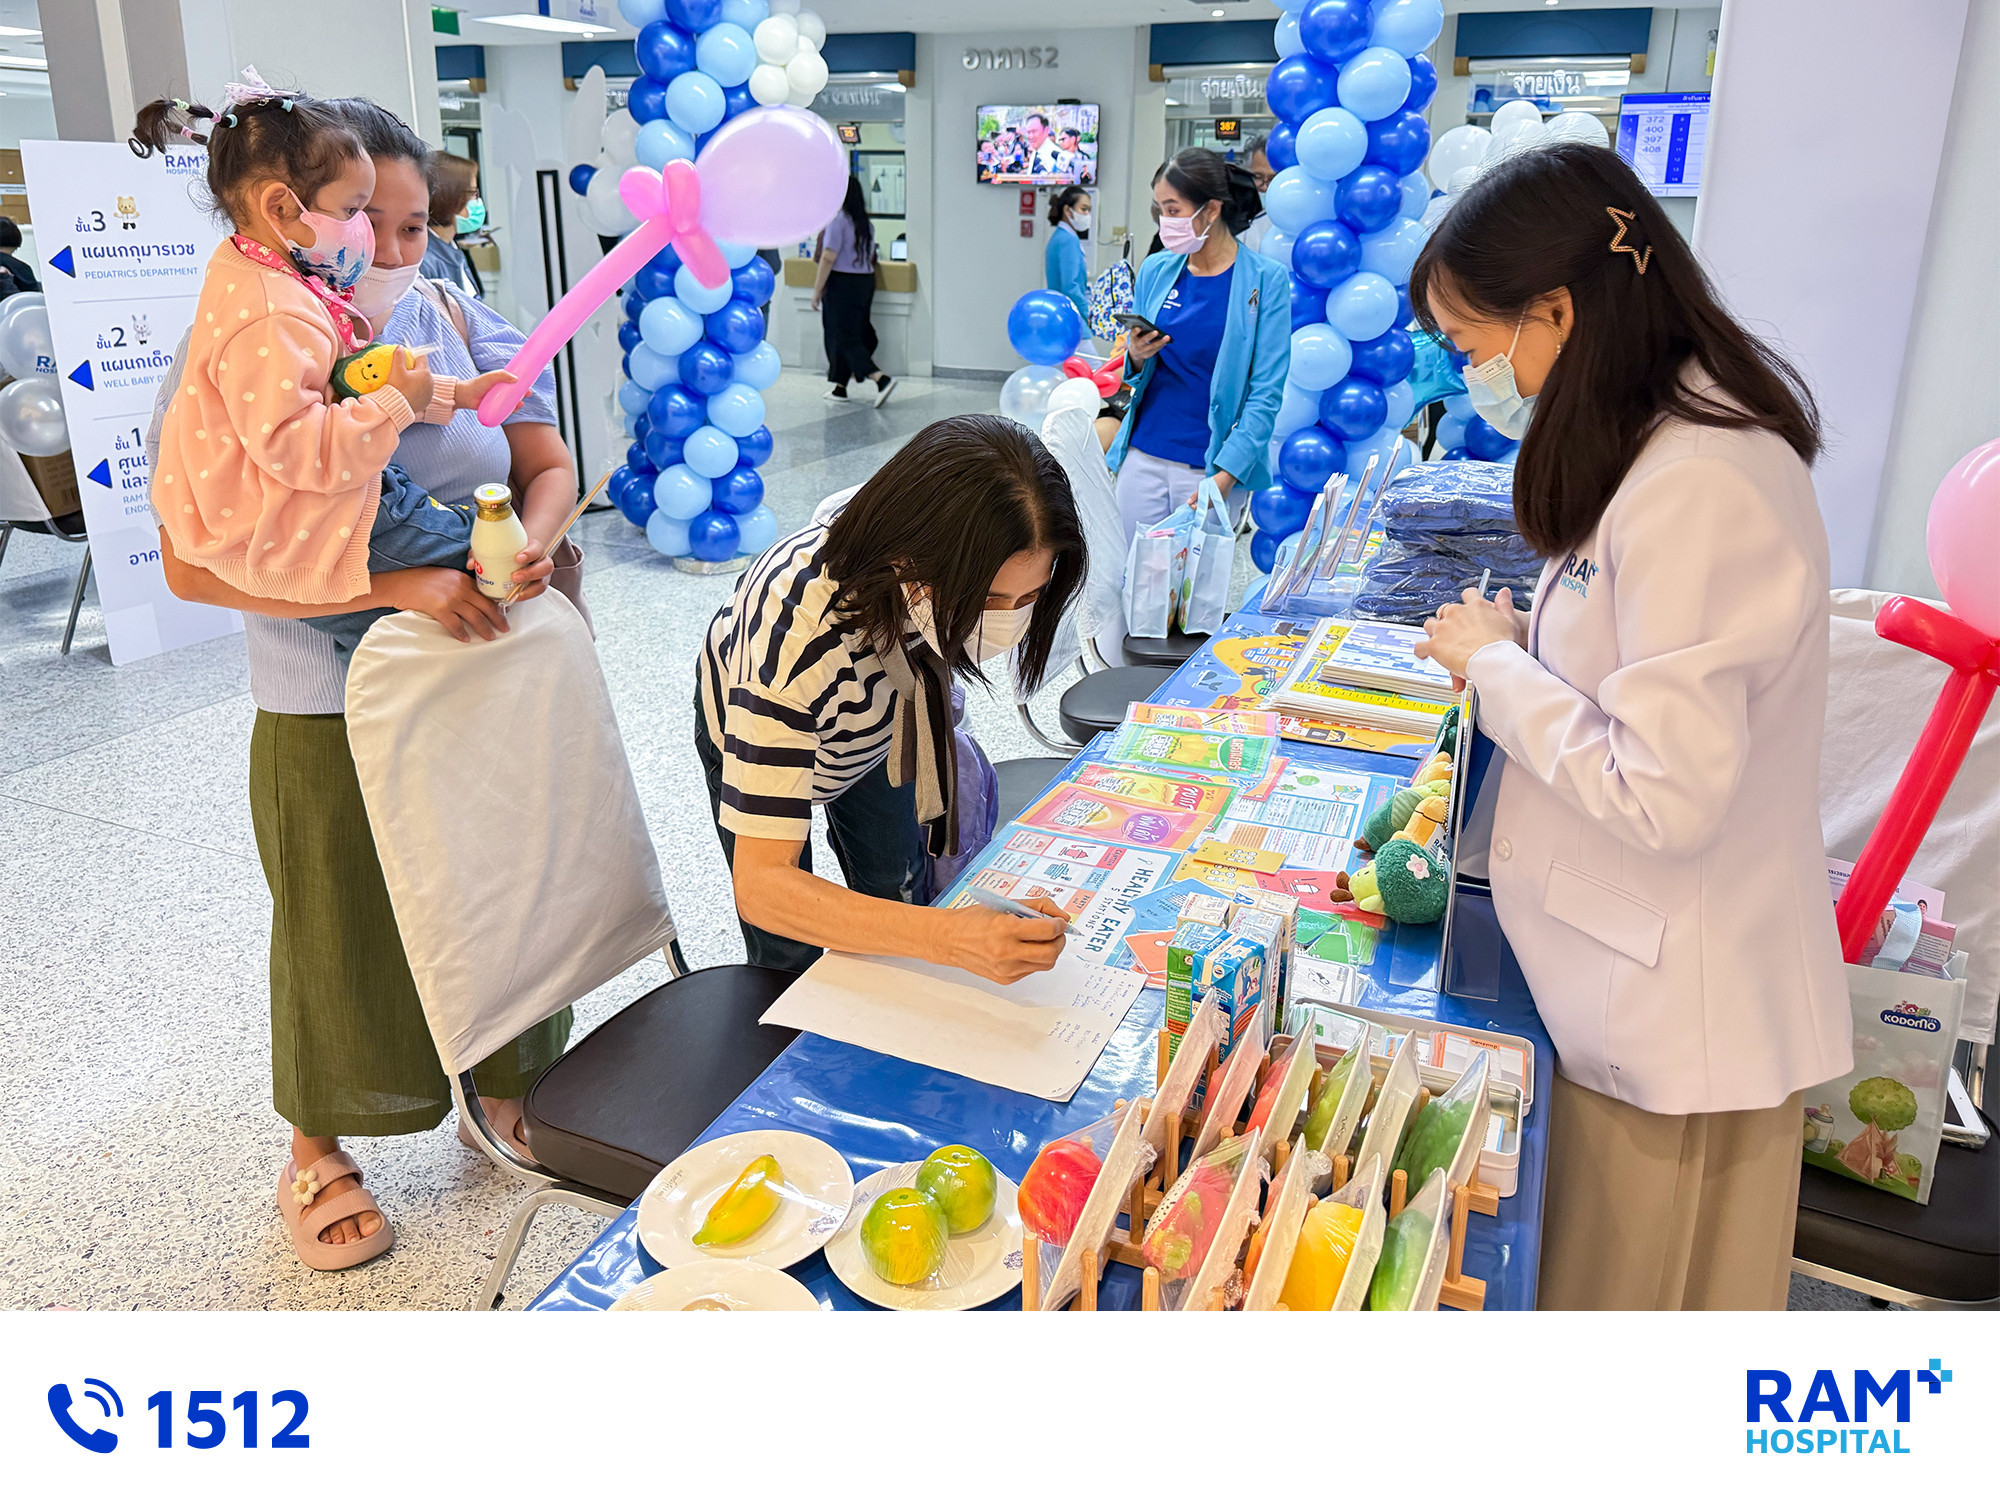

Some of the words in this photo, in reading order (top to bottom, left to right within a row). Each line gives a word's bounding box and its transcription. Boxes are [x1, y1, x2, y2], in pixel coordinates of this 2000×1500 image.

[1512, 69, 1581, 95] จ่ายเงิน
[1645, 115, 1665, 124] 372
[1644, 125, 1664, 133] 400
[1644, 135, 1663, 144] 397
[1642, 145, 1661, 153] 408
[164, 155, 200, 168] RAM
[82, 243, 195, 263] แผนกกุมารเวช
[84, 269, 138, 279] PEDIATRICS
[140, 267, 198, 277] DEPARTMENT
[103, 380, 130, 388] WELL
[131, 376, 155, 385] BABY
[123, 493, 143, 503] RAM
[129, 549, 162, 565] อาค
[1111, 868, 1154, 915] HEALTHY
[1076, 895, 1091, 909] PARTY
[1084, 917, 1121, 952] EATER
